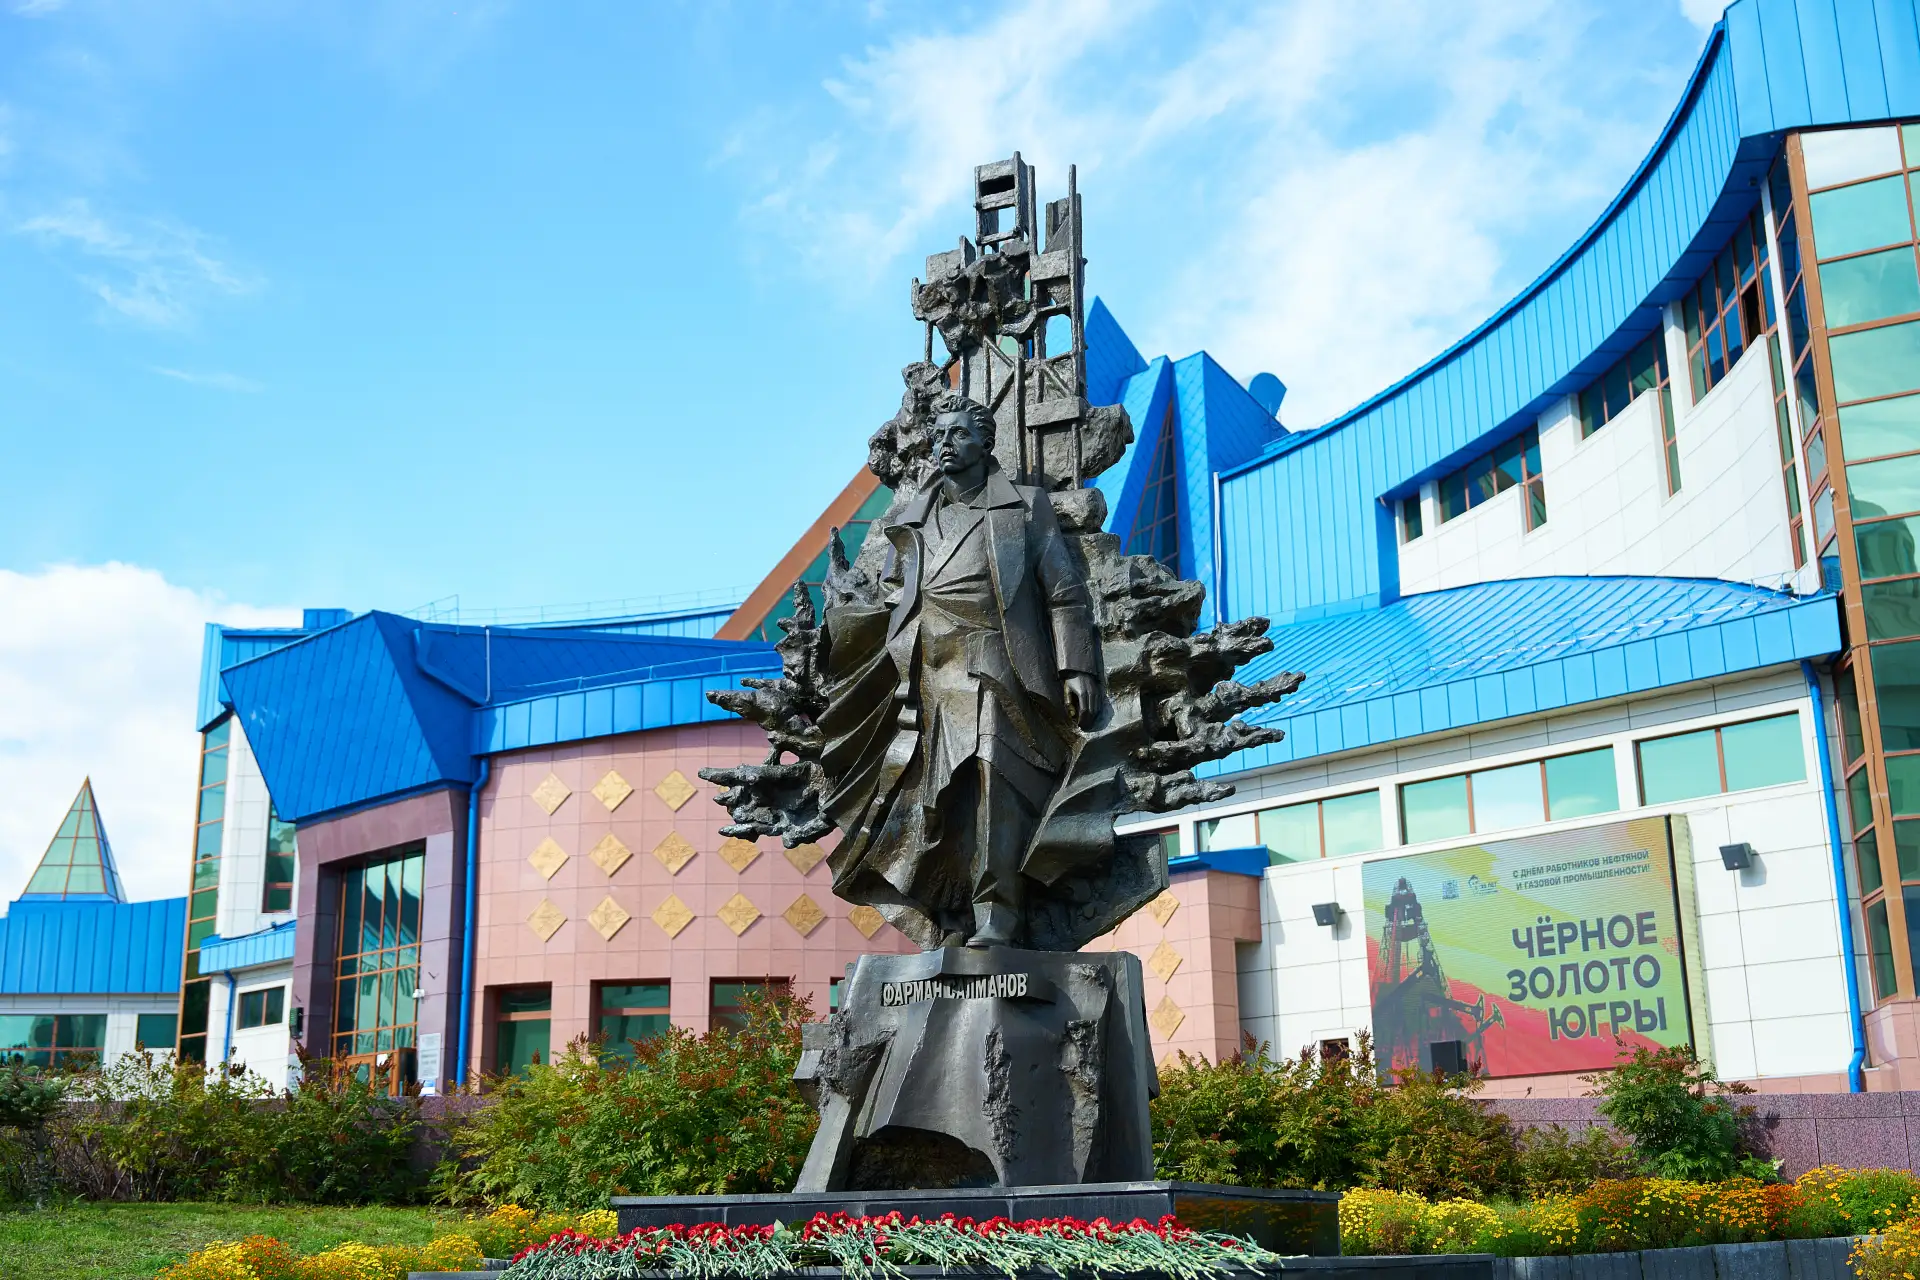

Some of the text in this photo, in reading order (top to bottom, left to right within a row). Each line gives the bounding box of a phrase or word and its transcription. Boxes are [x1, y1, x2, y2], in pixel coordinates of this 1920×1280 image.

[1512, 870, 1519, 878] С
[1546, 857, 1600, 873] РАБОТНИКОВ
[1602, 849, 1650, 865] НЕФТЯНОЙ
[1516, 864, 1650, 891] И ГАЗОВОЙ ПРОМЫШЛЕННОСТИ!
[1511, 911, 1658, 959] ЧЁРНОЕ
[883, 980, 943, 1006] ФАРМАН
[1505, 953, 1662, 1002] ЗОЛОТО
[1548, 997, 1668, 1041] ЮГРЫ
